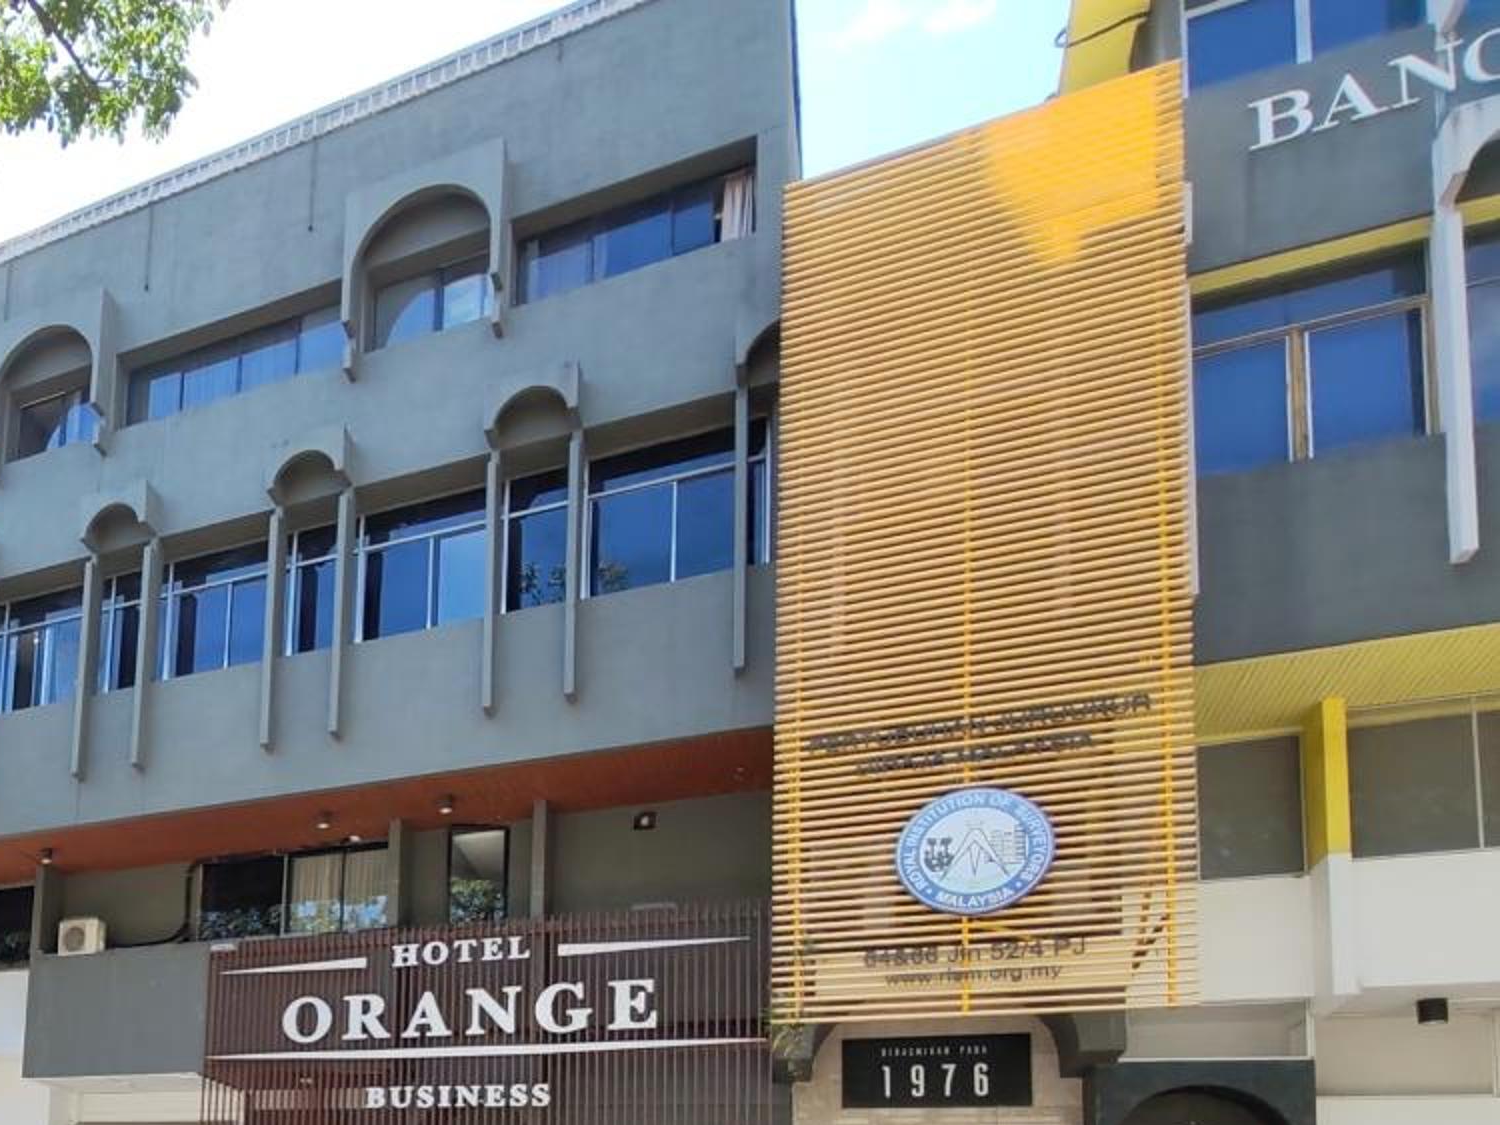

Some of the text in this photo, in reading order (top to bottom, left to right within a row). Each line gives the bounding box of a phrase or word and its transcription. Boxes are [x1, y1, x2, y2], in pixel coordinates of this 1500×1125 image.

[905, 793, 985, 848] INSTITUTION
[903, 848, 927, 891] ROYAL
[935, 887, 1015, 908] MALAYSIA
[391, 936, 531, 969] HOTEL
[281, 978, 658, 1044] ORANGE
[365, 1083, 551, 1109] BUSINESS
[881, 1062, 989, 1099] 1976
